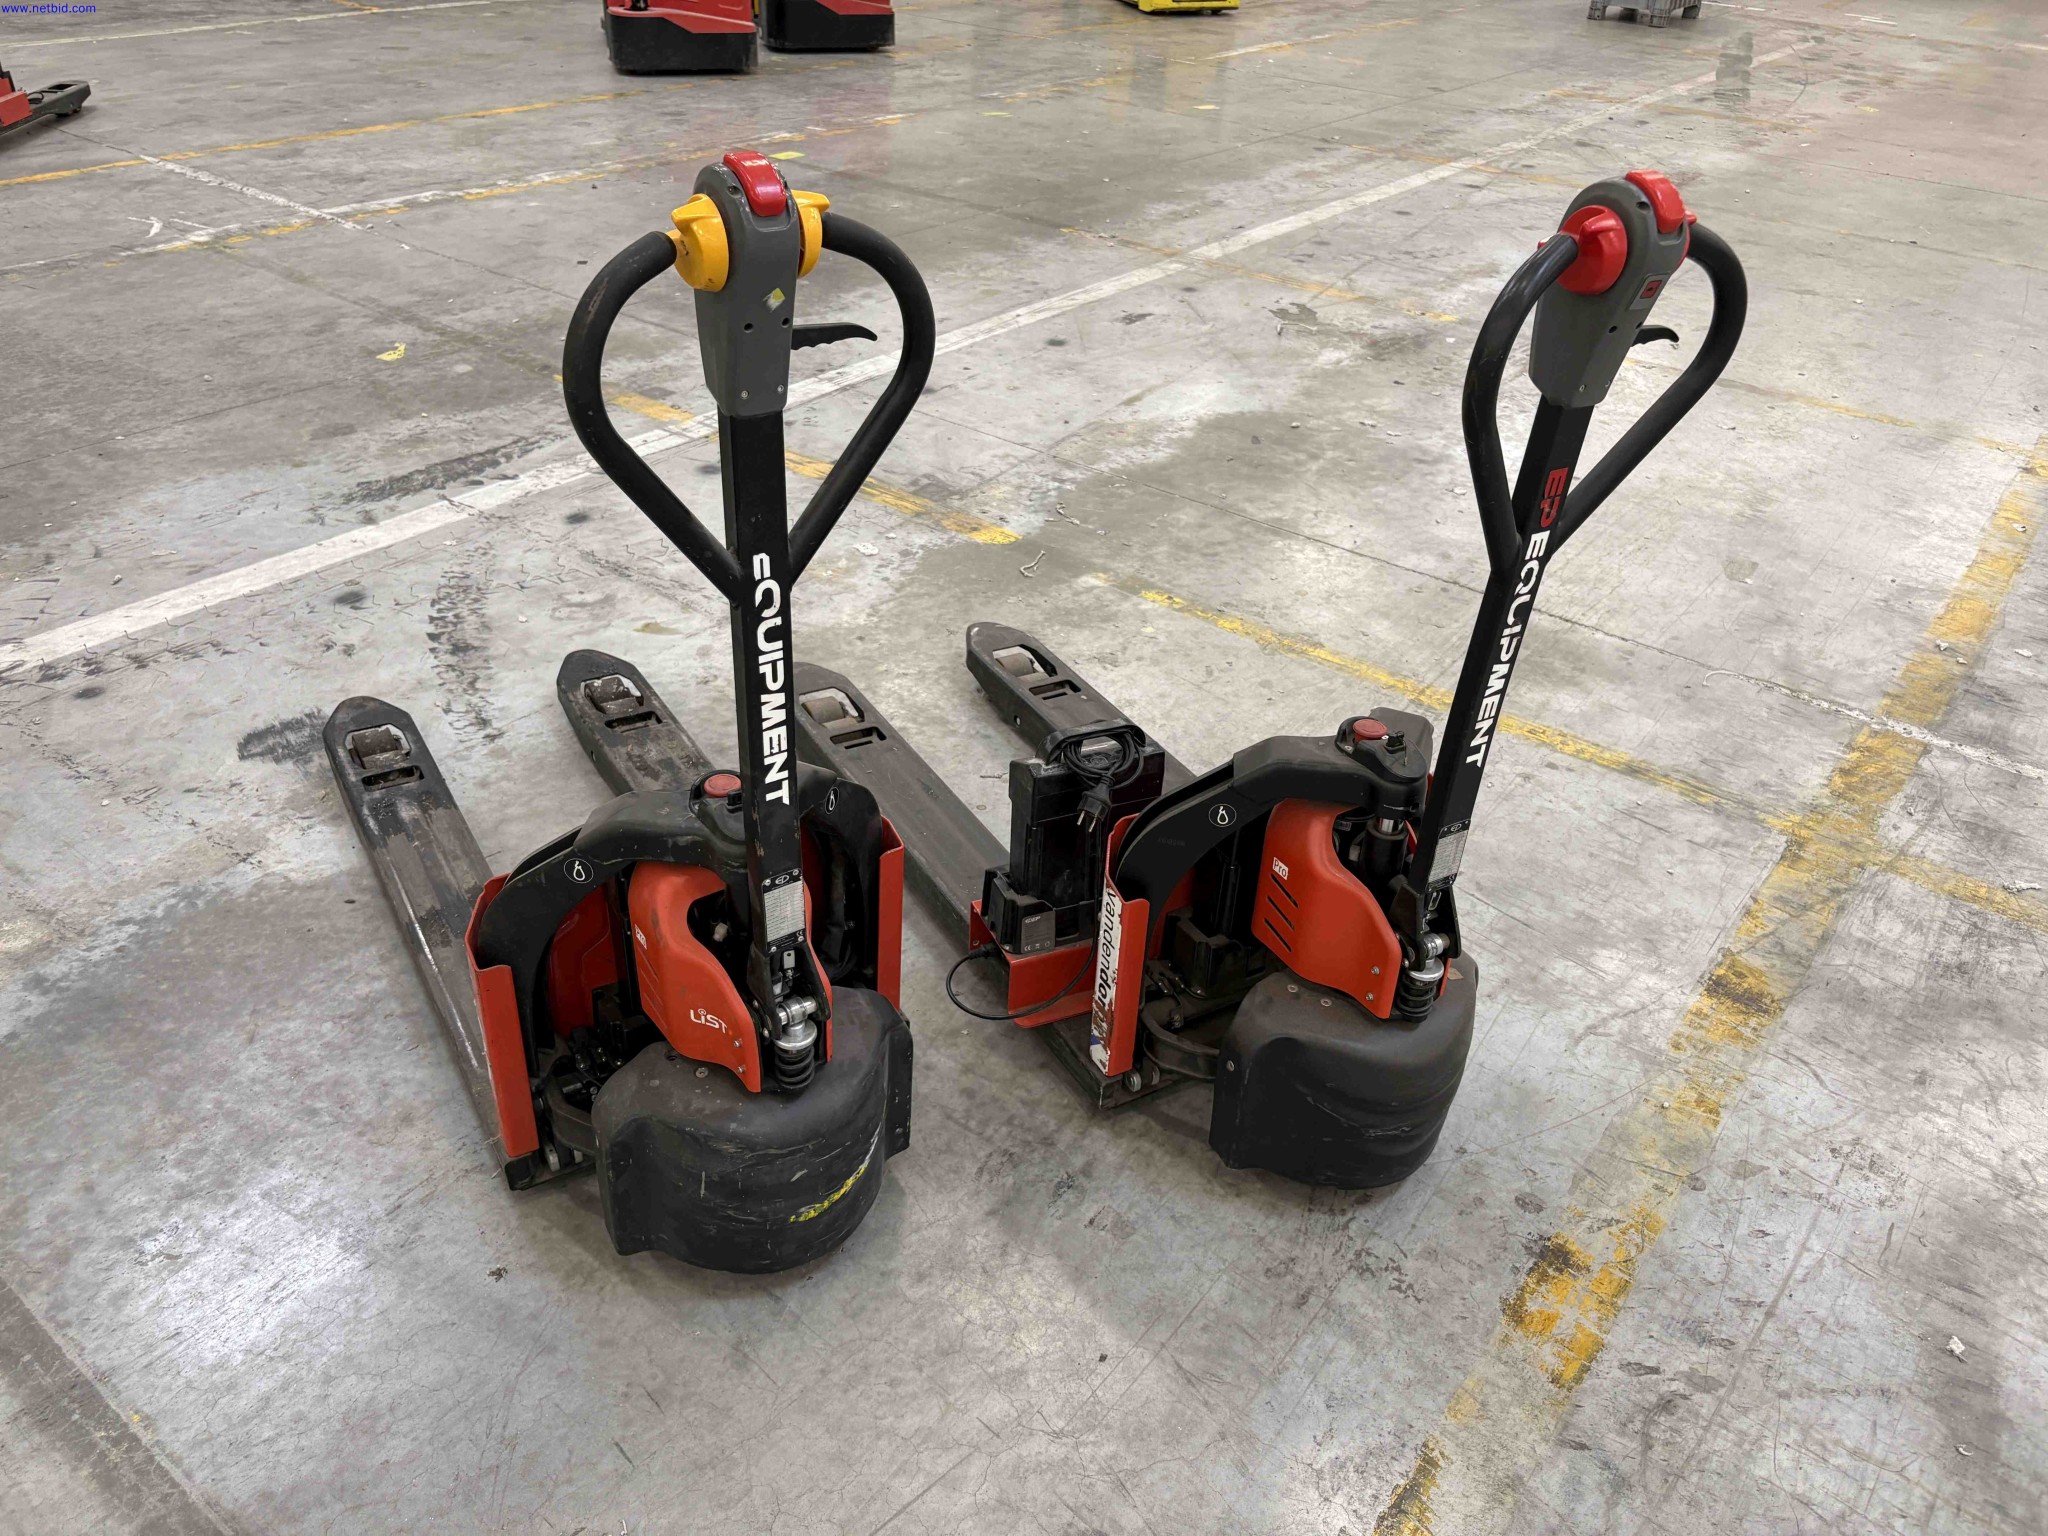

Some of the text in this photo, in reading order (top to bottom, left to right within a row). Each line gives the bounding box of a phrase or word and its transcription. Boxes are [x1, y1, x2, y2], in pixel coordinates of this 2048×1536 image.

[753, 552, 790, 806] EQUIPMENT
[1466, 467, 1568, 768] EP EQUIPMENT
[1273, 859, 1287, 878] Pro
